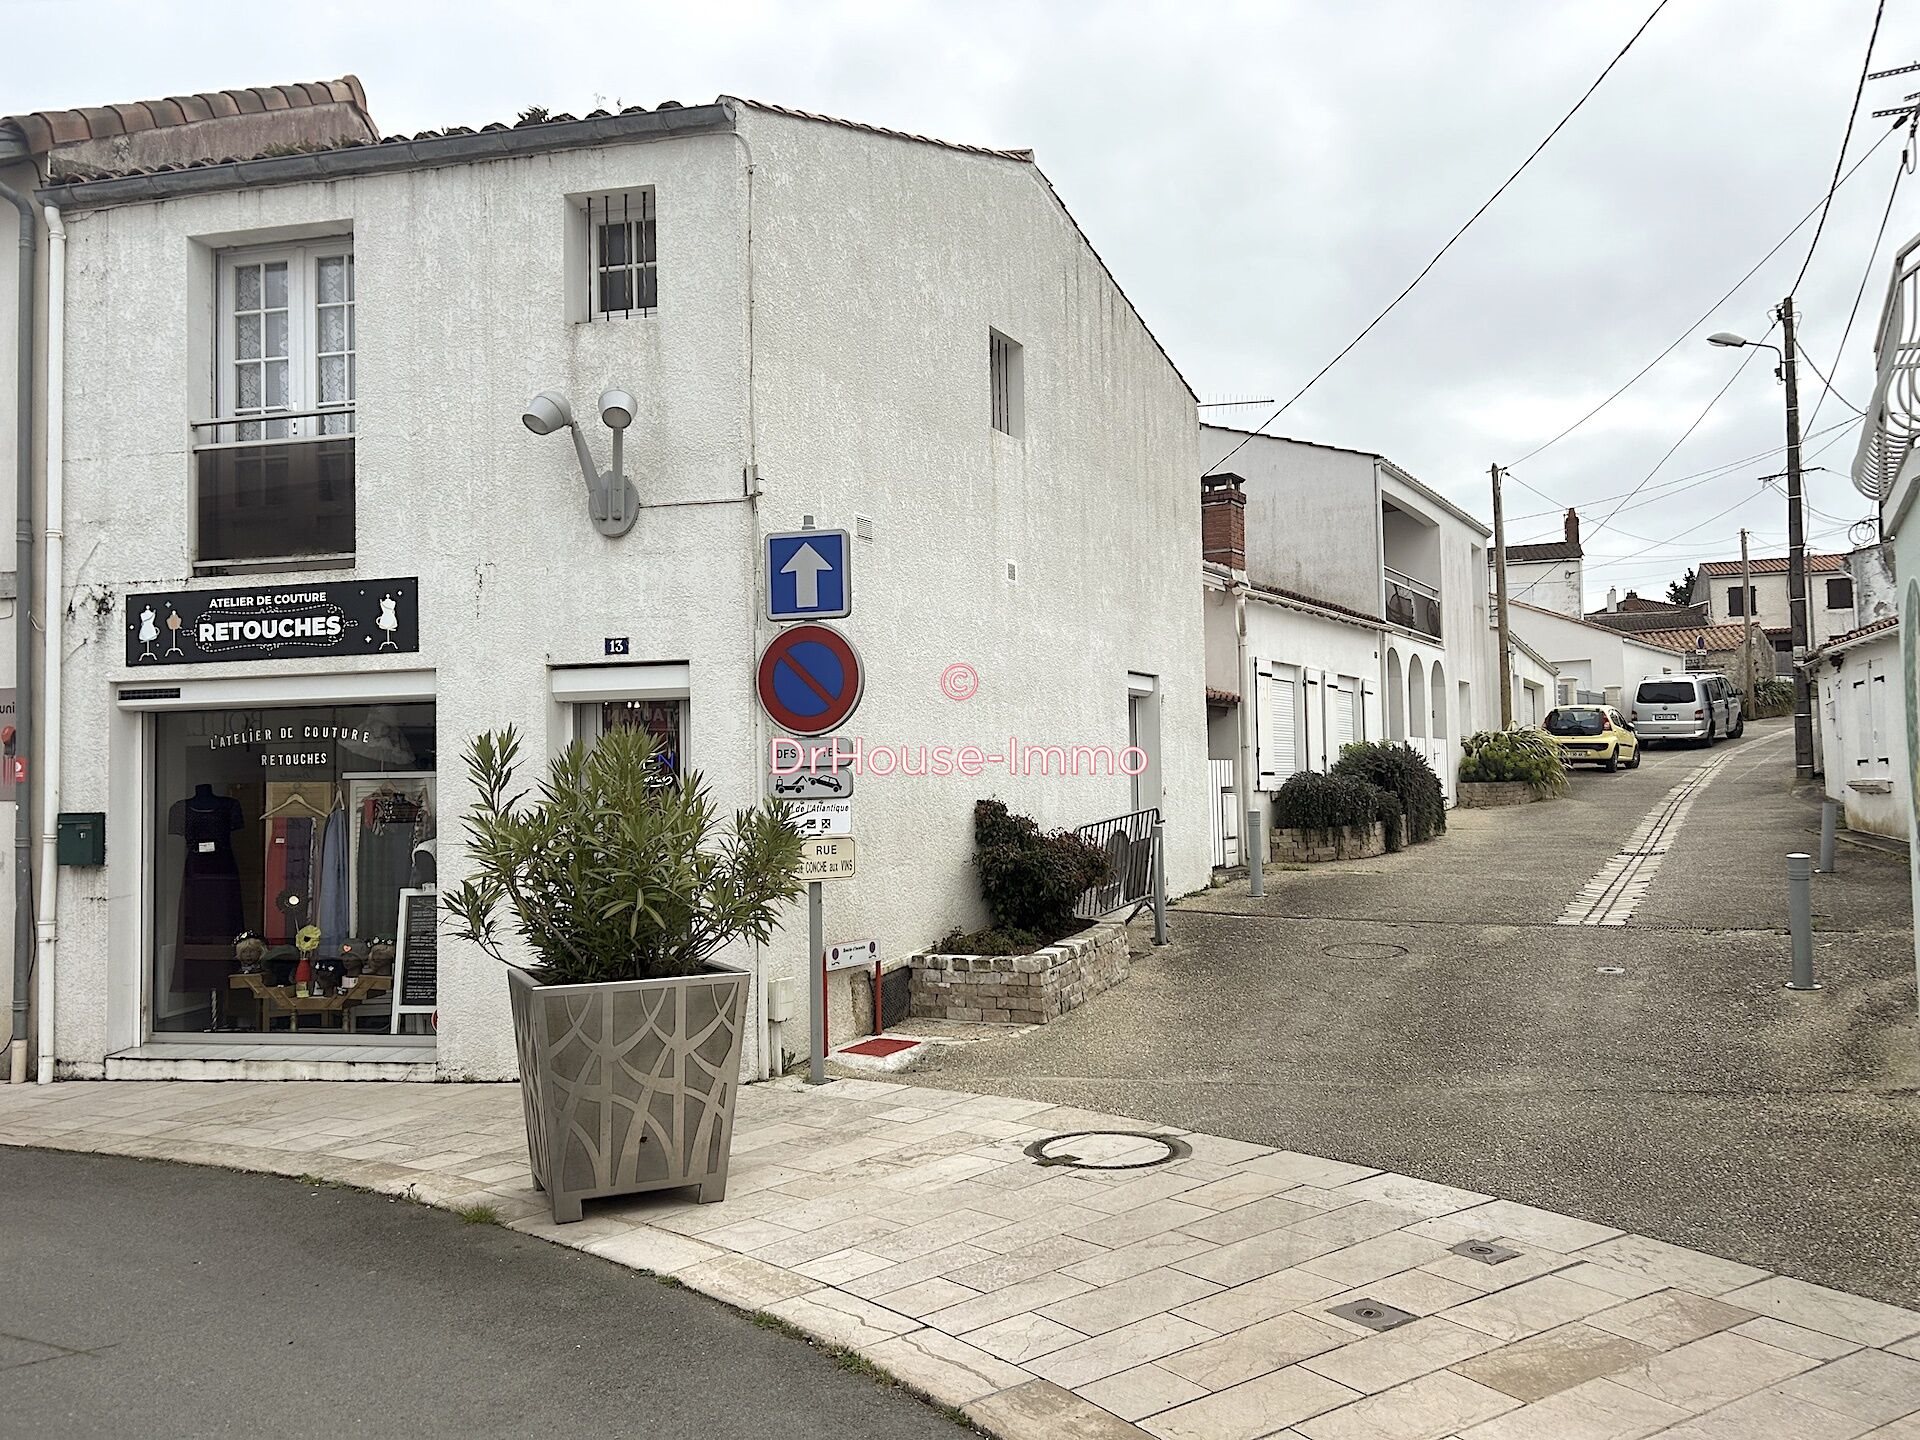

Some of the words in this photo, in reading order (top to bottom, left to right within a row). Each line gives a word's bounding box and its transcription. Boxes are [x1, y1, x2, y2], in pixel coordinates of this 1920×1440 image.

[209, 597, 254, 608] ATELIER
[256, 595, 272, 606] DE
[274, 592, 327, 604] COUTURE
[199, 616, 341, 642] RETOUCHES
[609, 639, 624, 652] 13
[280, 727, 294, 739] DE
[304, 726, 370, 743] COUTURE
[261, 752, 327, 766] RETOUCHES
[816, 844, 837, 855] RUE
